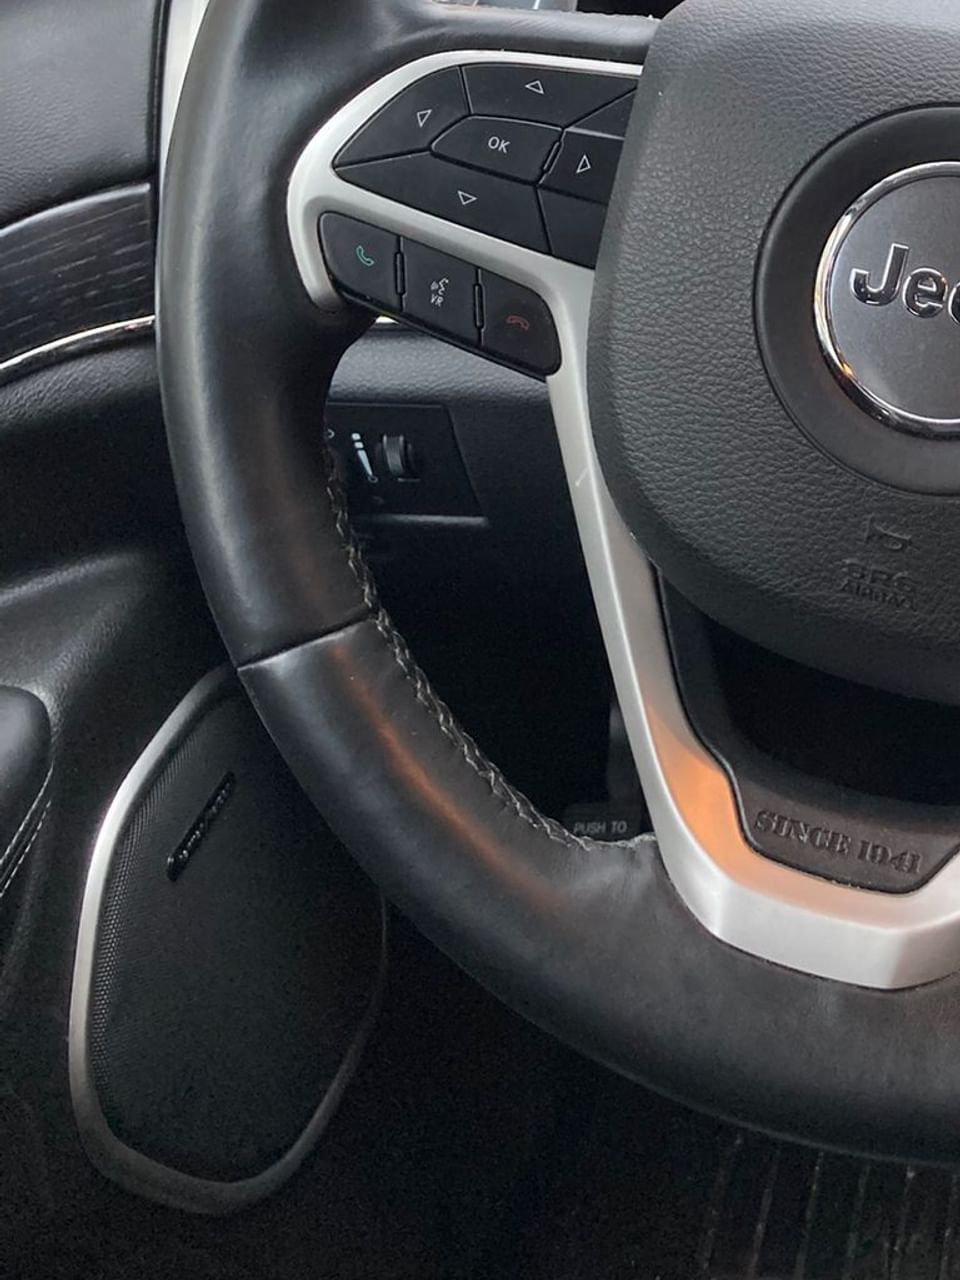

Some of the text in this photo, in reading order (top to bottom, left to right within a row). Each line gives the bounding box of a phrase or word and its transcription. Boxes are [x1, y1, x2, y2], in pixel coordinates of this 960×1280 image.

[488, 136, 510, 153] OK
[755, 810, 922, 874] SINCE 1941
